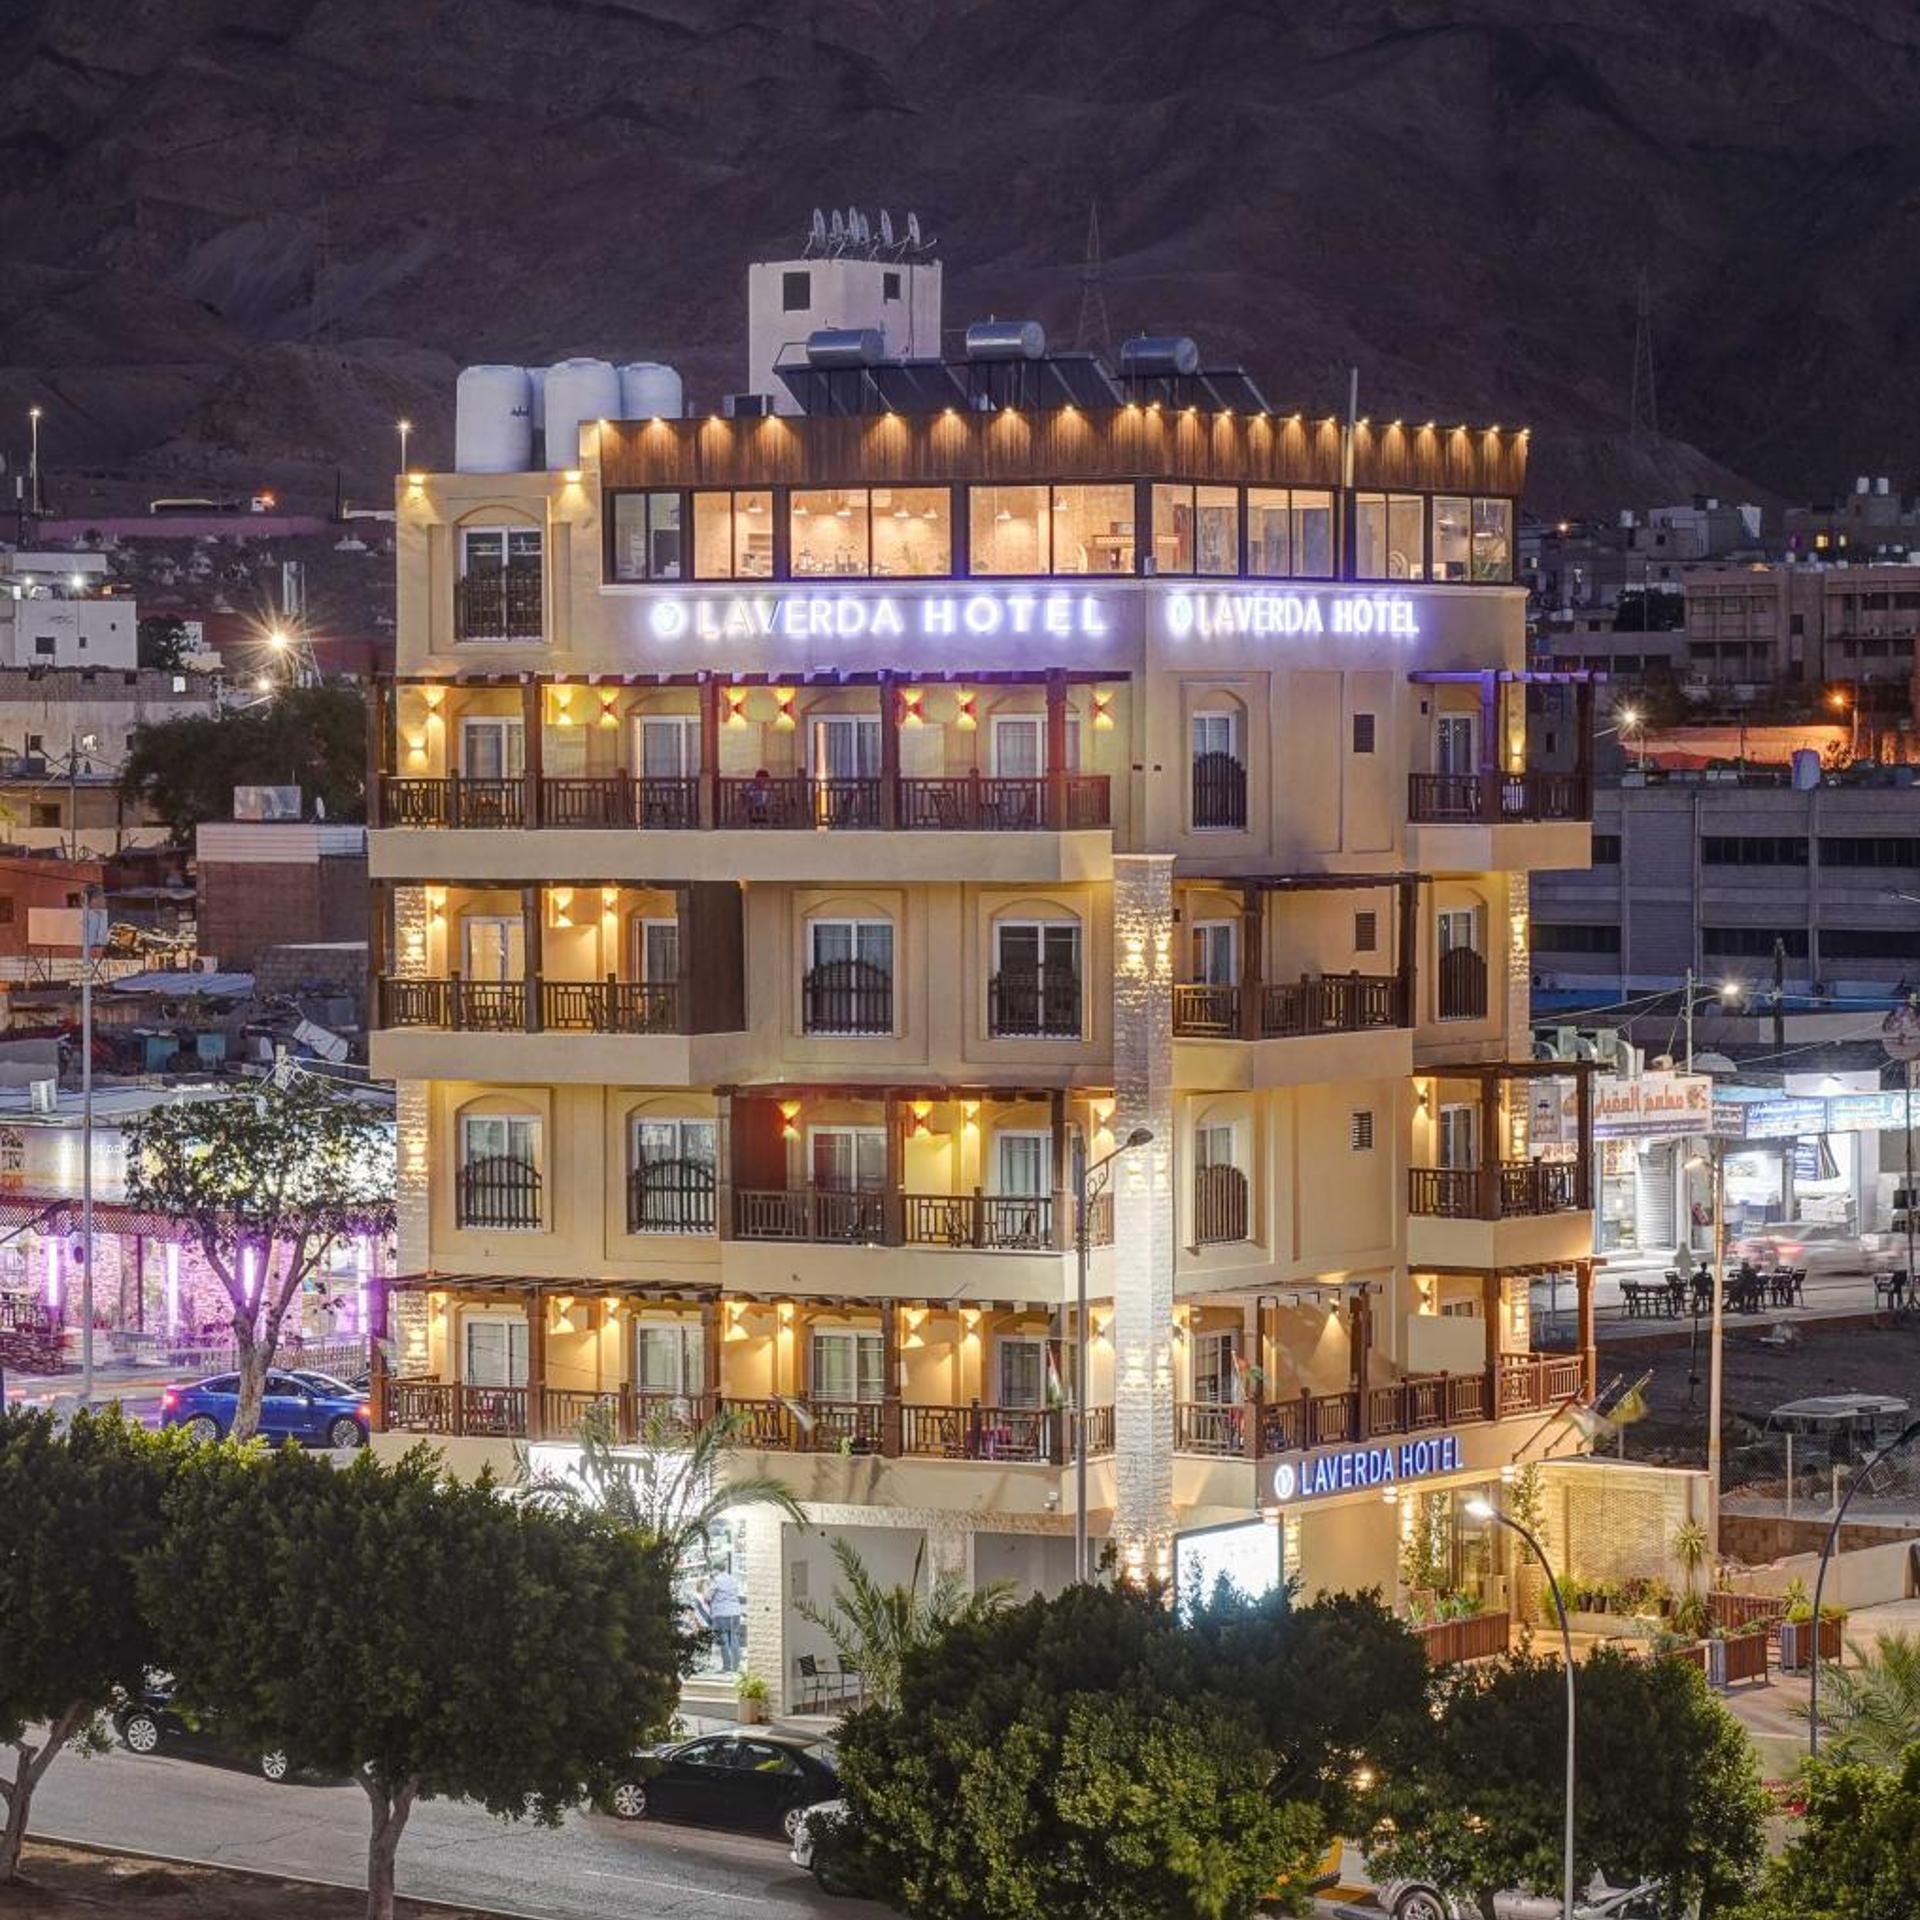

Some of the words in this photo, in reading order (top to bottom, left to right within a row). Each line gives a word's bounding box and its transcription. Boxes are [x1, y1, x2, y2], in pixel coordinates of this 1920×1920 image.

[701, 598, 902, 636] LAVERDA
[924, 597, 1107, 635] HOTEL
[1197, 597, 1324, 635] LAVERDA
[1334, 598, 1420, 633] HOTEL
[1300, 1447, 1395, 1496] LAVERDA
[1400, 1436, 1464, 1478] HOTEL
